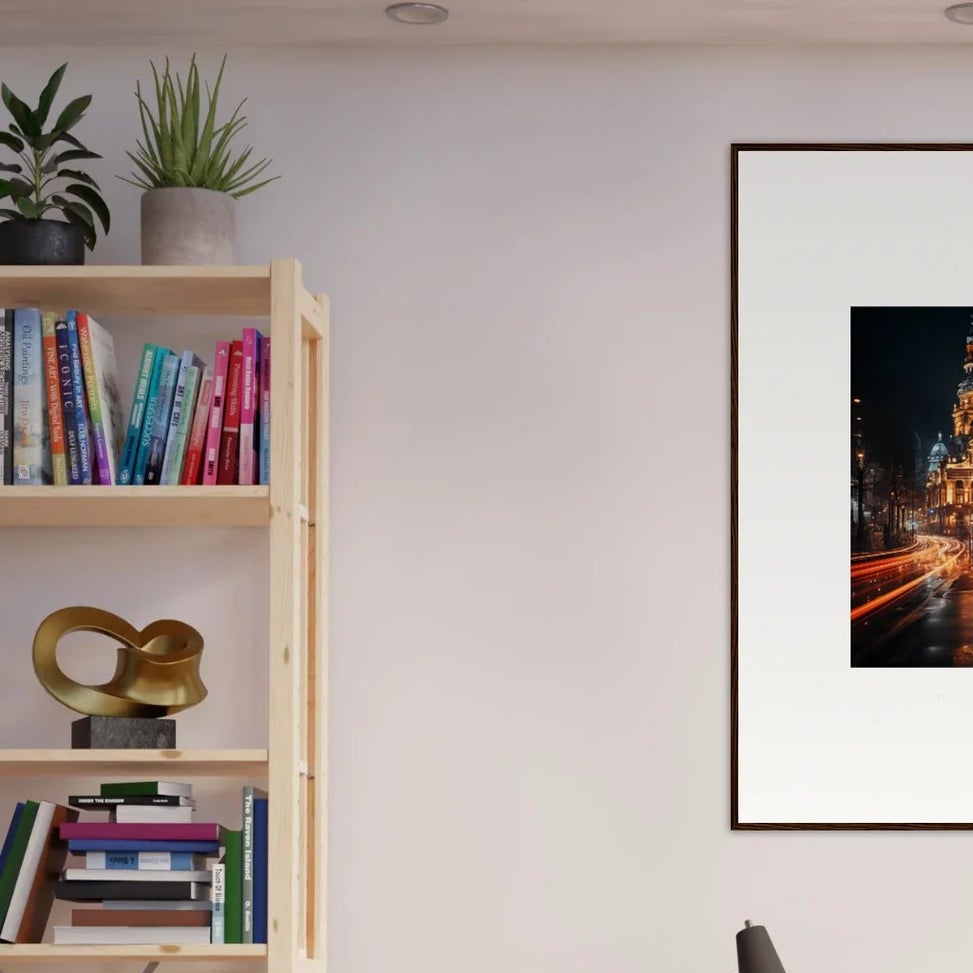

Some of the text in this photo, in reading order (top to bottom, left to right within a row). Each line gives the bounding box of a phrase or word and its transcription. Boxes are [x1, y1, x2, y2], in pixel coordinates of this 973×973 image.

[19, 325, 32, 386] Oil Paintings
[47, 347, 56, 363] FINE
[48, 363, 57, 379] ART
[59, 344, 73, 409] ICONIC
[80, 326, 97, 412] Watercolor Portraits
[49, 385, 58, 401] With
[229, 363, 241, 416] Parenting Skills
[48, 402, 60, 425] Digital
[142, 396, 157, 447] SUCCESSFUL
[52, 426, 62, 443] Tools
[215, 868, 223, 884] Touch
